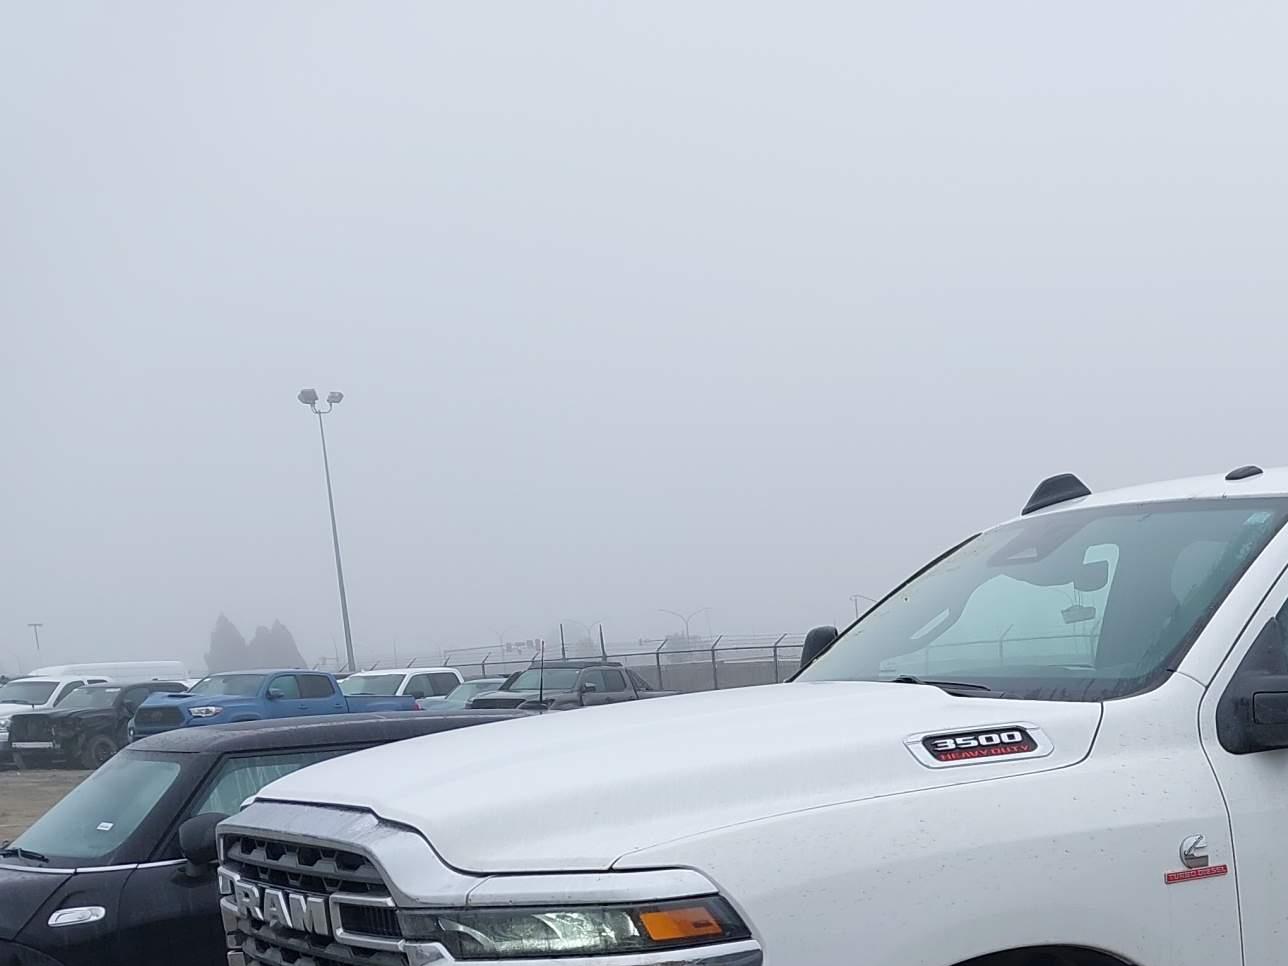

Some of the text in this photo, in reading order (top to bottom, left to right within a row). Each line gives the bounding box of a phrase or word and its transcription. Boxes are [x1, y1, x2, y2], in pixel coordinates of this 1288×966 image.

[931, 731, 1023, 751] 3500
[939, 744, 1030, 761] HEAVY DUTY
[234, 879, 330, 936] RAM
